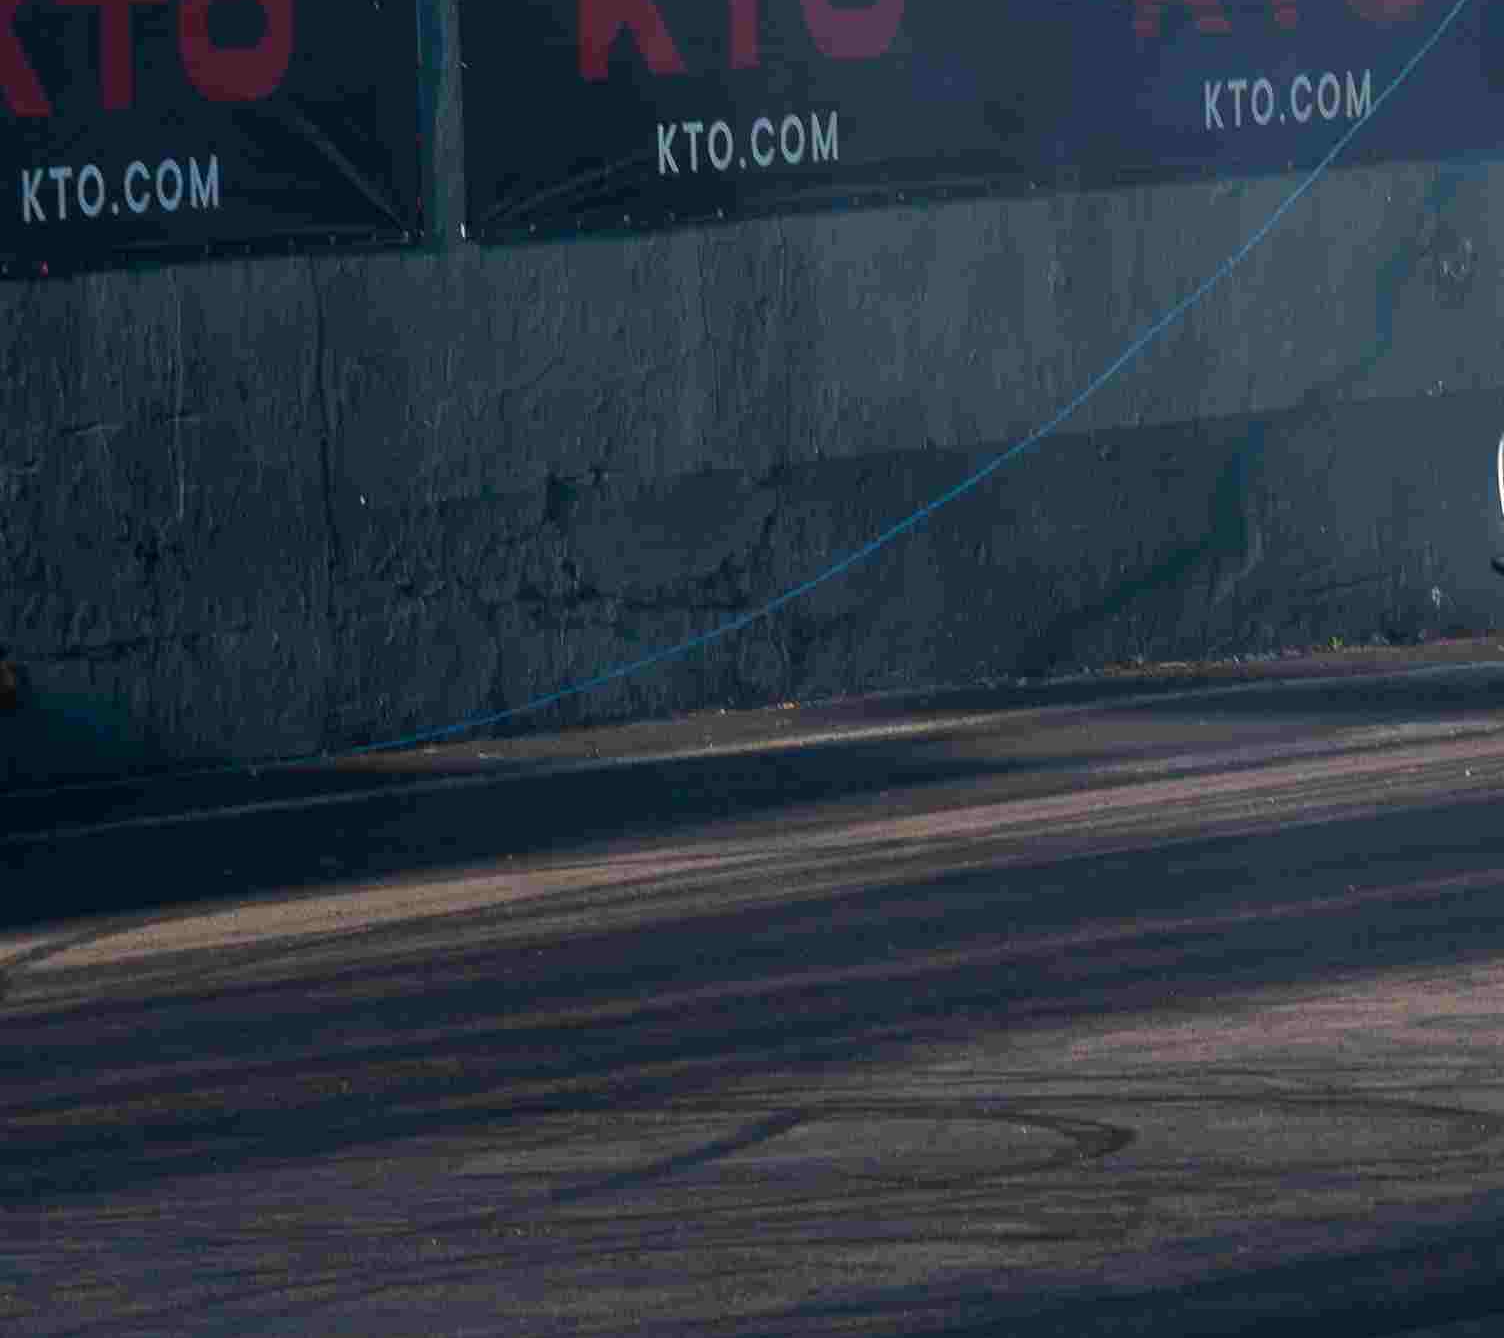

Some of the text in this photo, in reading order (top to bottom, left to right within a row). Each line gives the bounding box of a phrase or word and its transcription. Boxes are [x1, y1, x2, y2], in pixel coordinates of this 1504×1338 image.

[1202, 69, 1374, 132] KTO.COM
[656, 110, 840, 177] KTO.COM
[20, 153, 222, 224] KTO.COM
